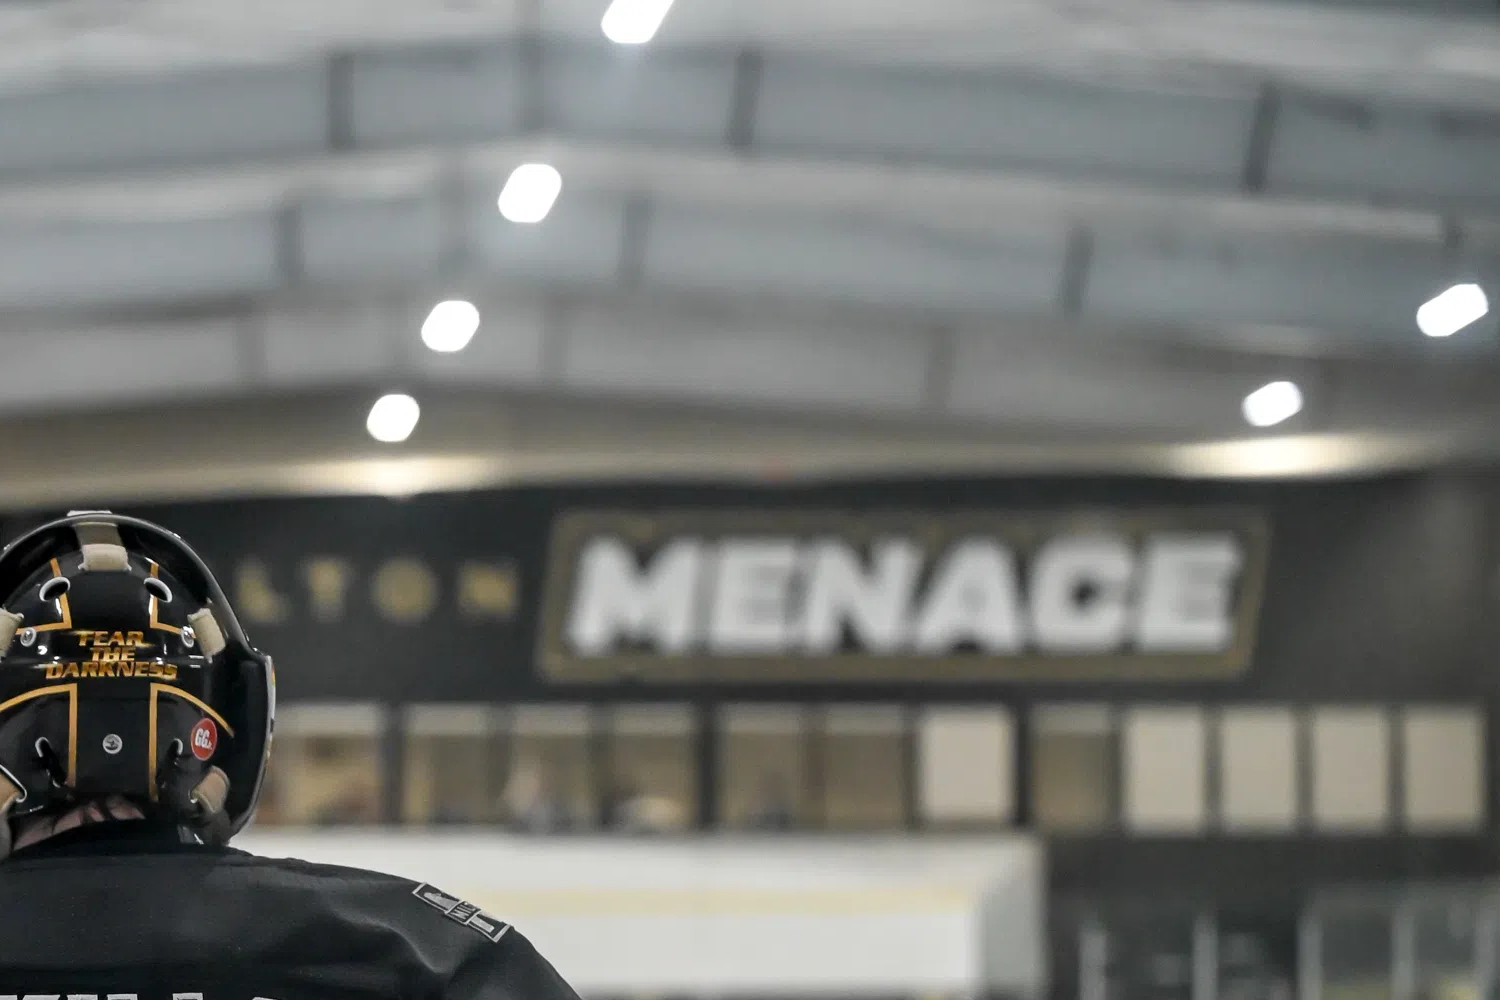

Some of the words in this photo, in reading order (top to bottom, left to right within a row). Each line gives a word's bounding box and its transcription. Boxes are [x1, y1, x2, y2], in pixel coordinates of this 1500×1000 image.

[570, 534, 1239, 654] MENACE
[90, 647, 137, 662] THE
[44, 661, 179, 681] DARKNESS
